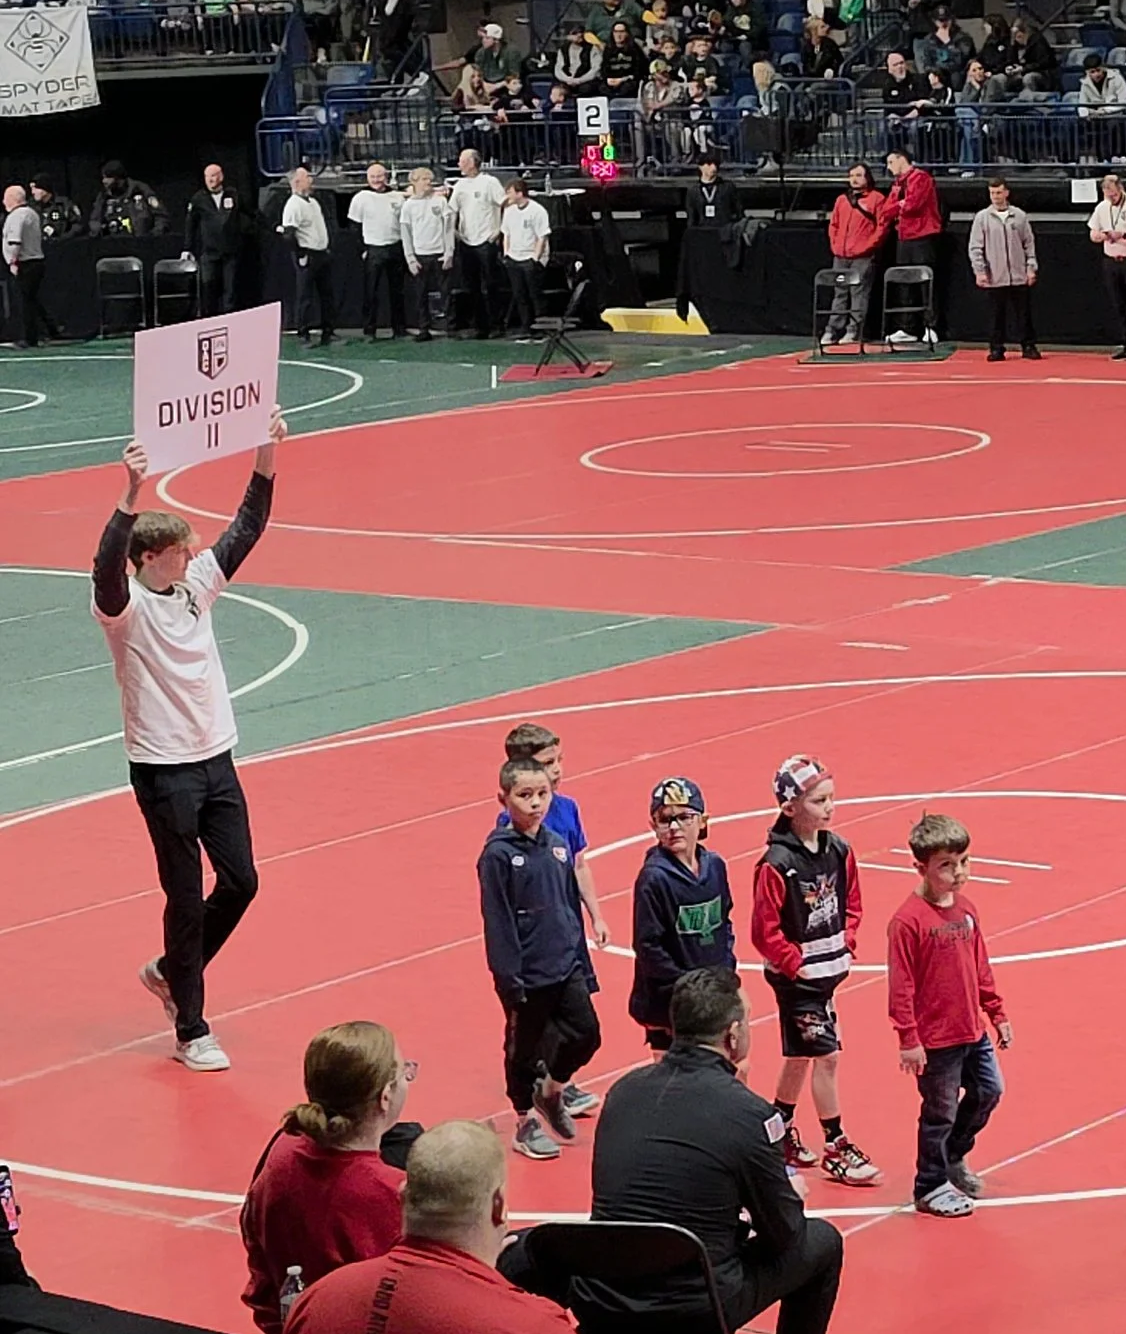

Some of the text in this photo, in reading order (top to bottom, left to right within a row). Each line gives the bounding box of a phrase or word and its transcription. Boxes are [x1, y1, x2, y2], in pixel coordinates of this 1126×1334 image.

[0, 75, 91, 99] SPYDER
[1, 93, 94, 115] MAT TAPE
[585, 105, 601, 128] 2
[158, 380, 261, 428] DIVISION
[206, 422, 219, 449] II
